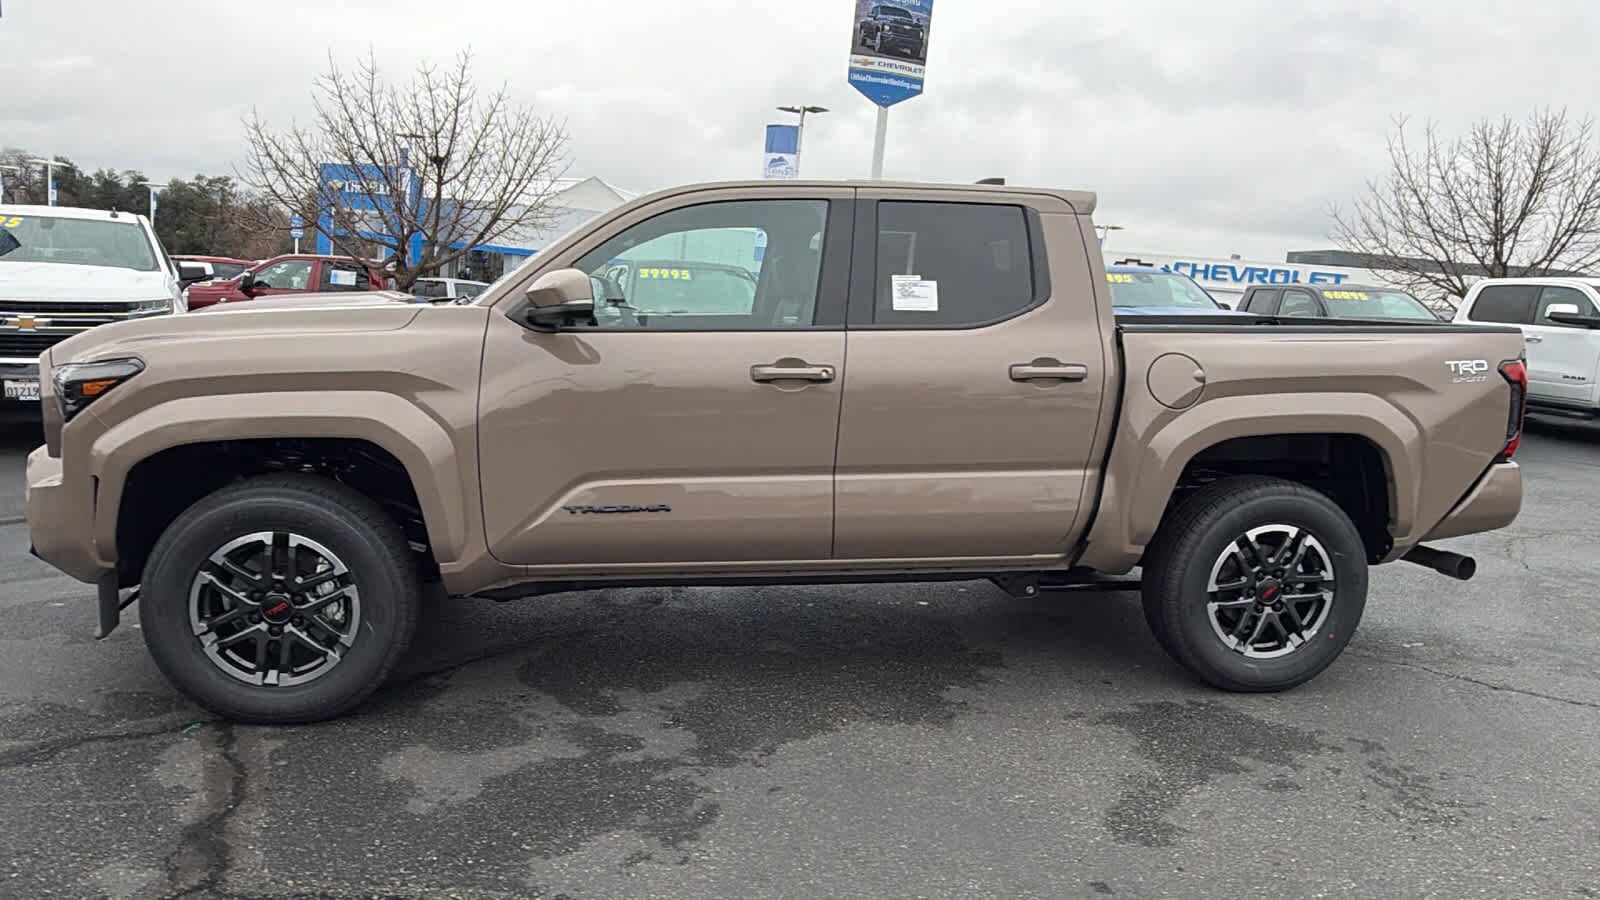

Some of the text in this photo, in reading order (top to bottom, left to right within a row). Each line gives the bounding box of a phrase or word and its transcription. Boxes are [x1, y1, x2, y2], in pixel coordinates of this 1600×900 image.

[878, 61, 924, 73] CHEVROLET
[1444, 359, 1488, 375] TRD
[562, 504, 672, 514] TACOMA
